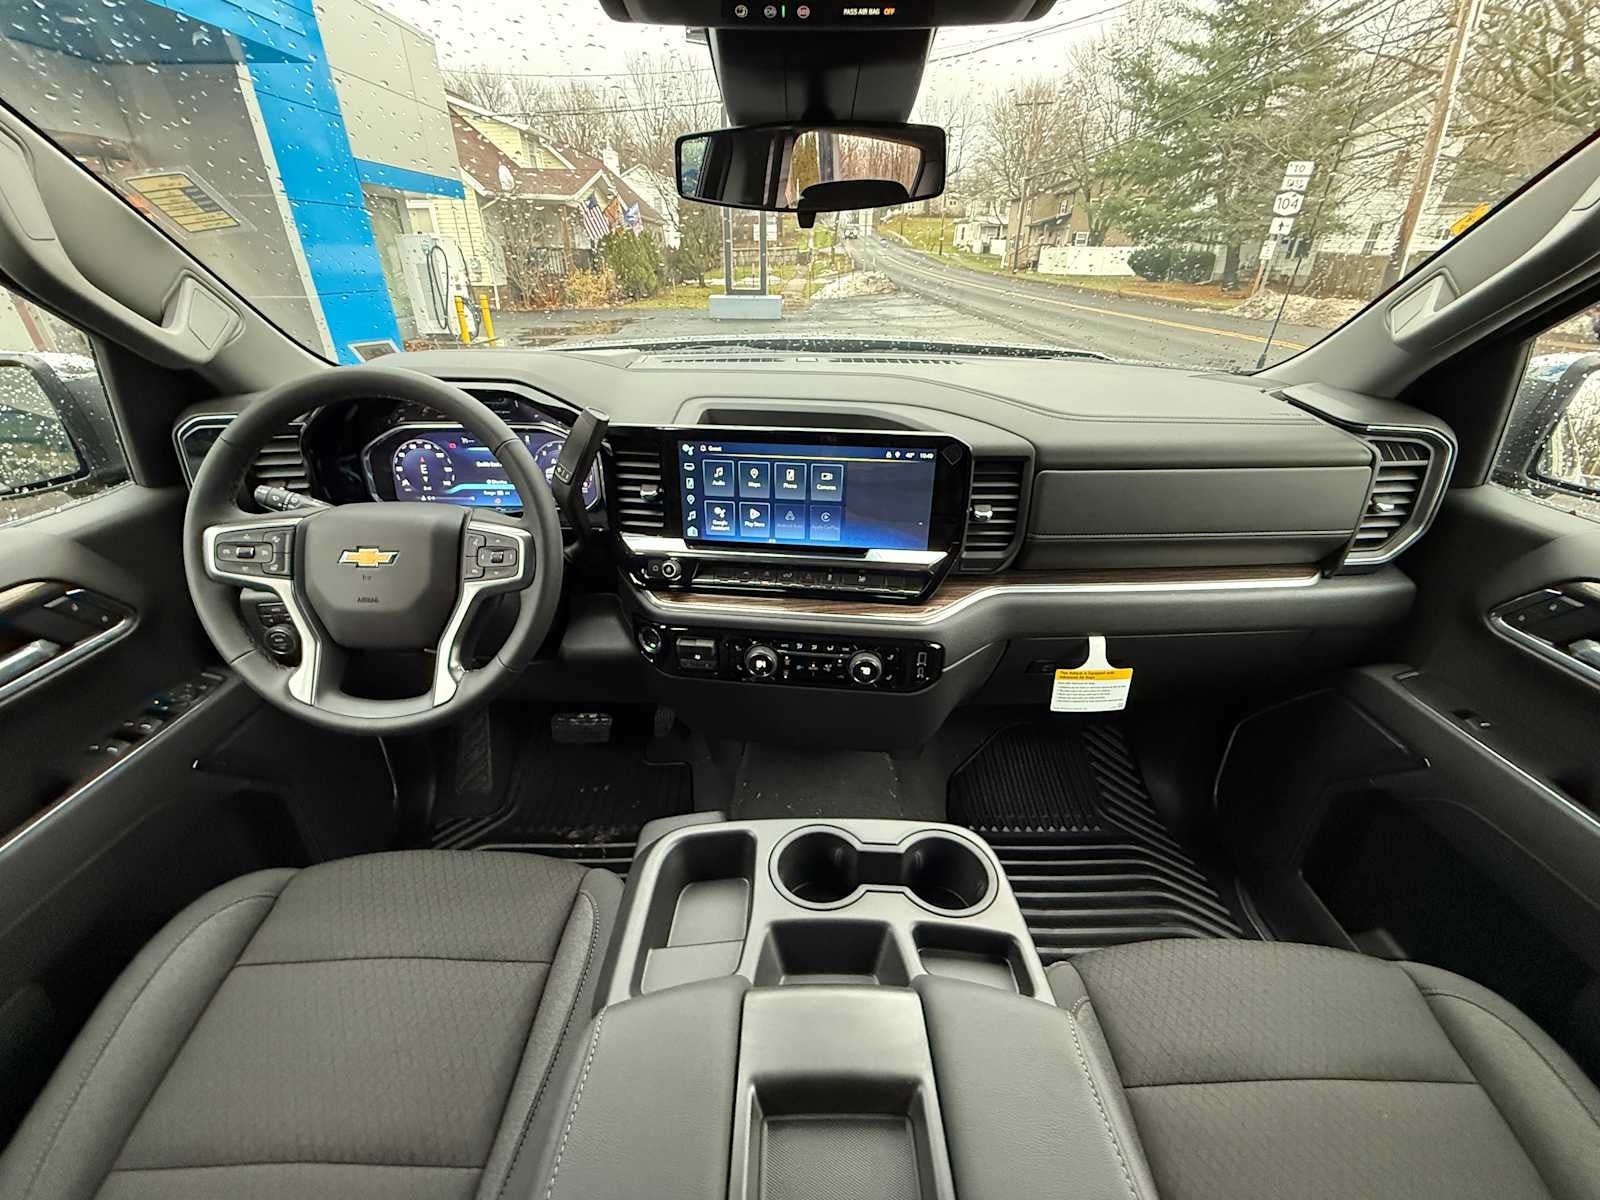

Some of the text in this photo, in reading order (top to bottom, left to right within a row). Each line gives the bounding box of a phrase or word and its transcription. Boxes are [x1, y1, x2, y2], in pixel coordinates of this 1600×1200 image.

[843, 7, 895, 16] PASS AIR BAG OFF
[1277, 197, 1299, 210] 104
[816, 483, 837, 491] Cameras
